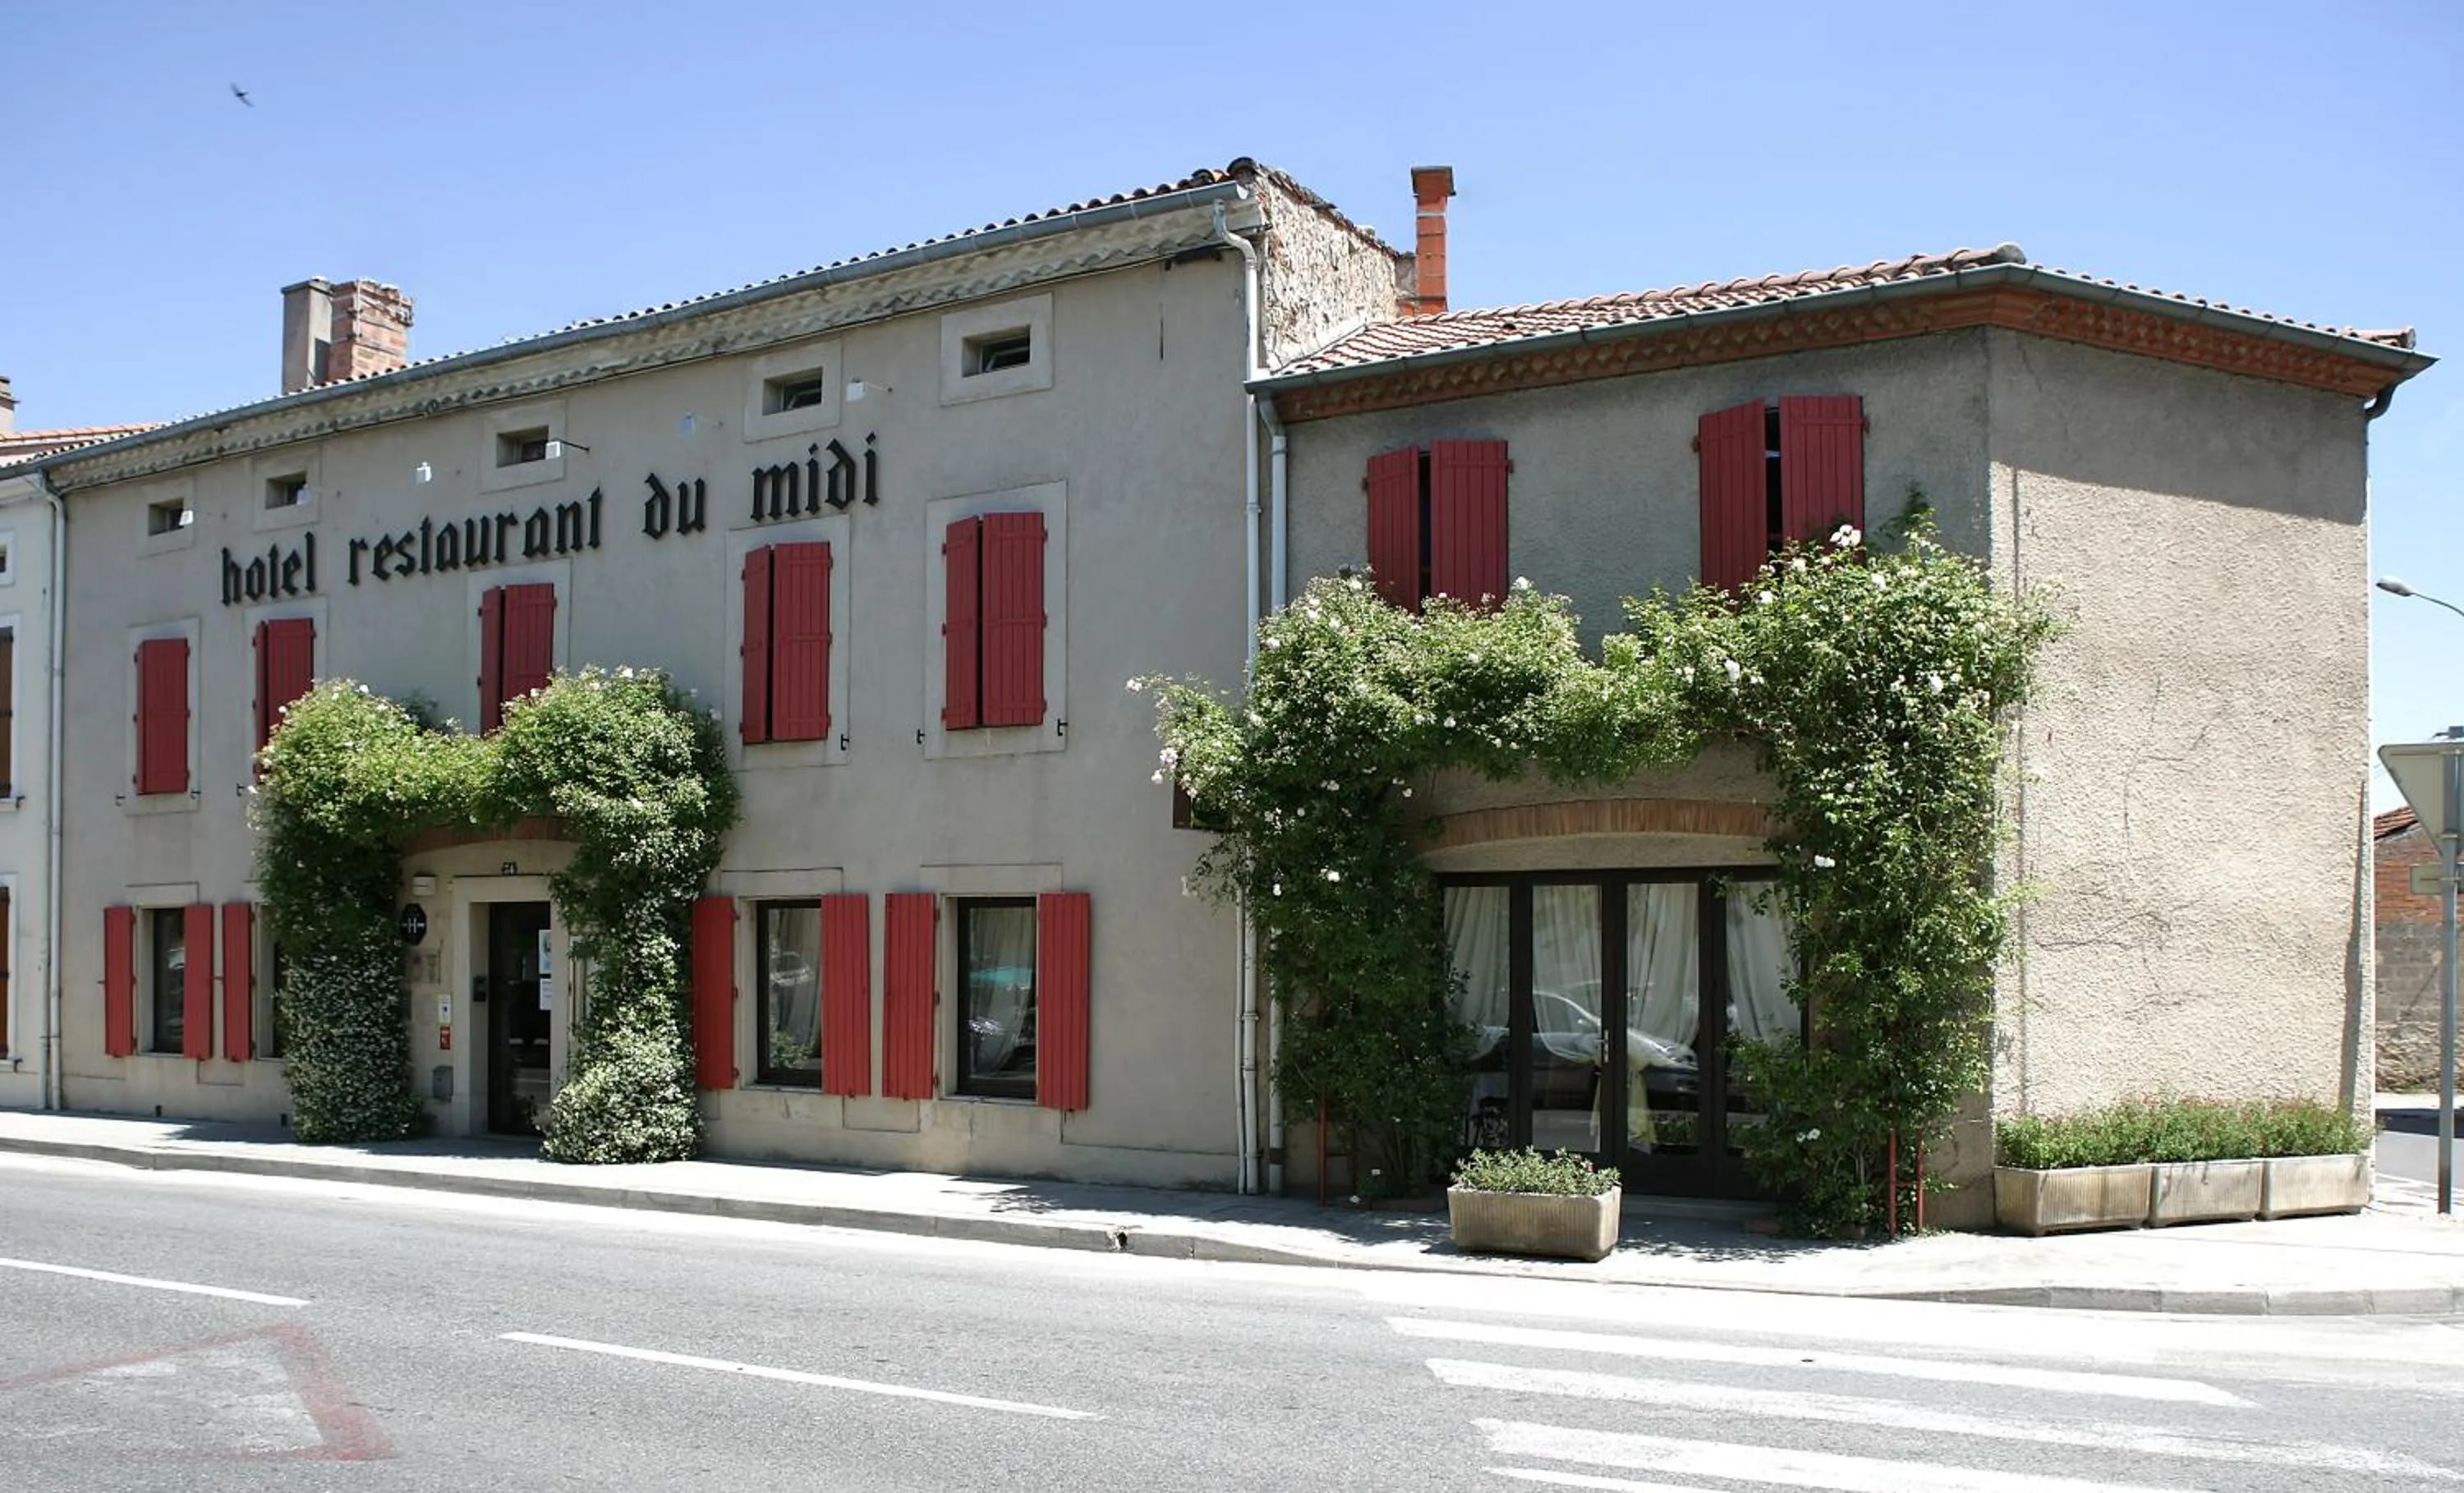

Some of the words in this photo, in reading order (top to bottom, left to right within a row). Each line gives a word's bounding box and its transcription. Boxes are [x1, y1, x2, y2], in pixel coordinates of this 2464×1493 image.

[221, 531, 316, 606] hotel
[348, 486, 603, 586] restaurant
[642, 472, 706, 540] du
[751, 431, 879, 521] midi
